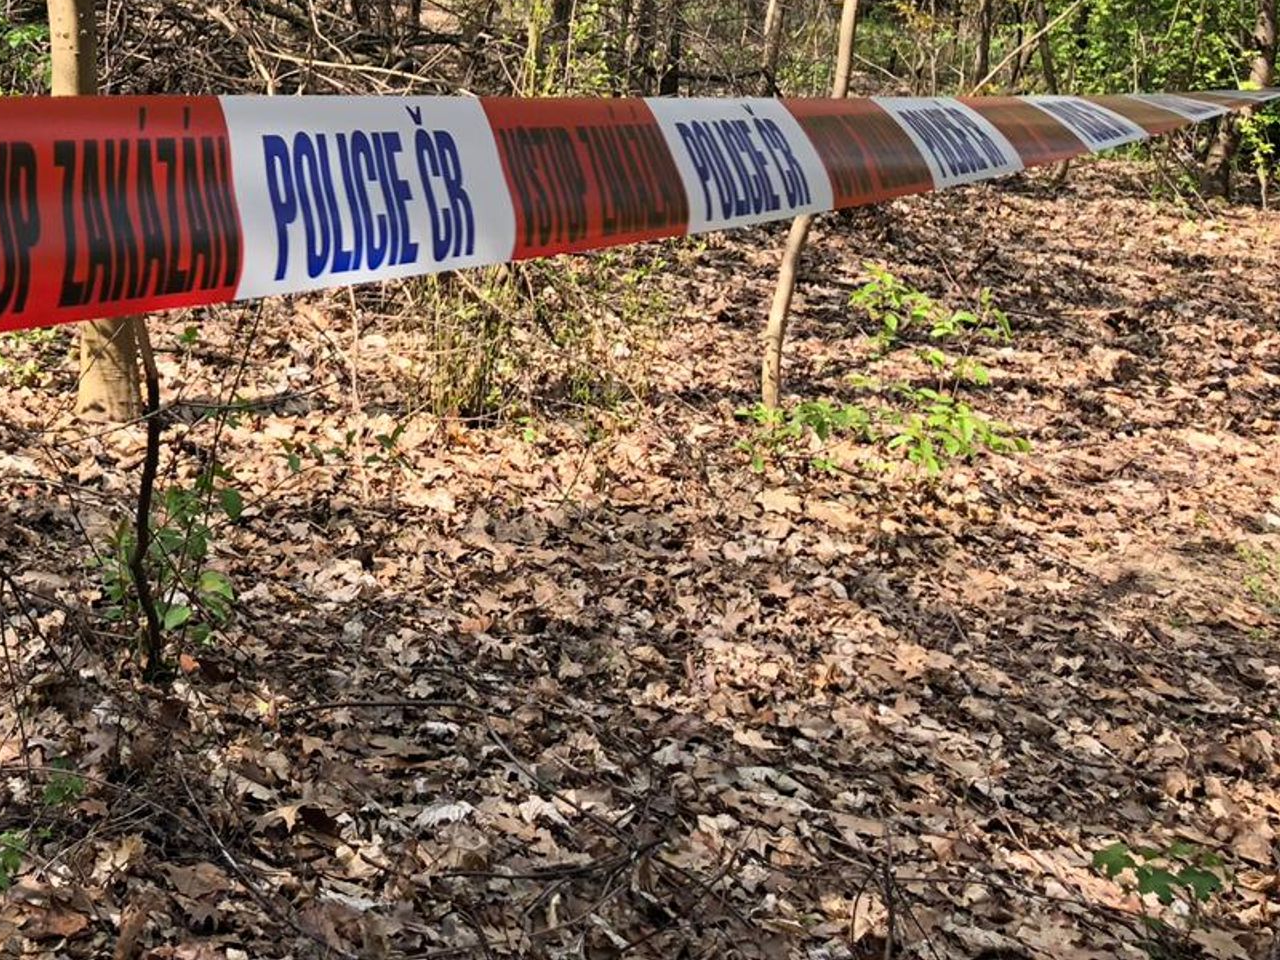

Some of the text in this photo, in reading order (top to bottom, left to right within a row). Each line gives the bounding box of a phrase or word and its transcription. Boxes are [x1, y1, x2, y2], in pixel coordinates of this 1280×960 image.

[54, 107, 239, 308] ZAKÁZÁN
[262, 105, 475, 281] POLICIE ČR
[499, 125, 588, 247] VSTUP
[675, 119, 781, 222] POLICIE
[741, 103, 812, 210] ČR
